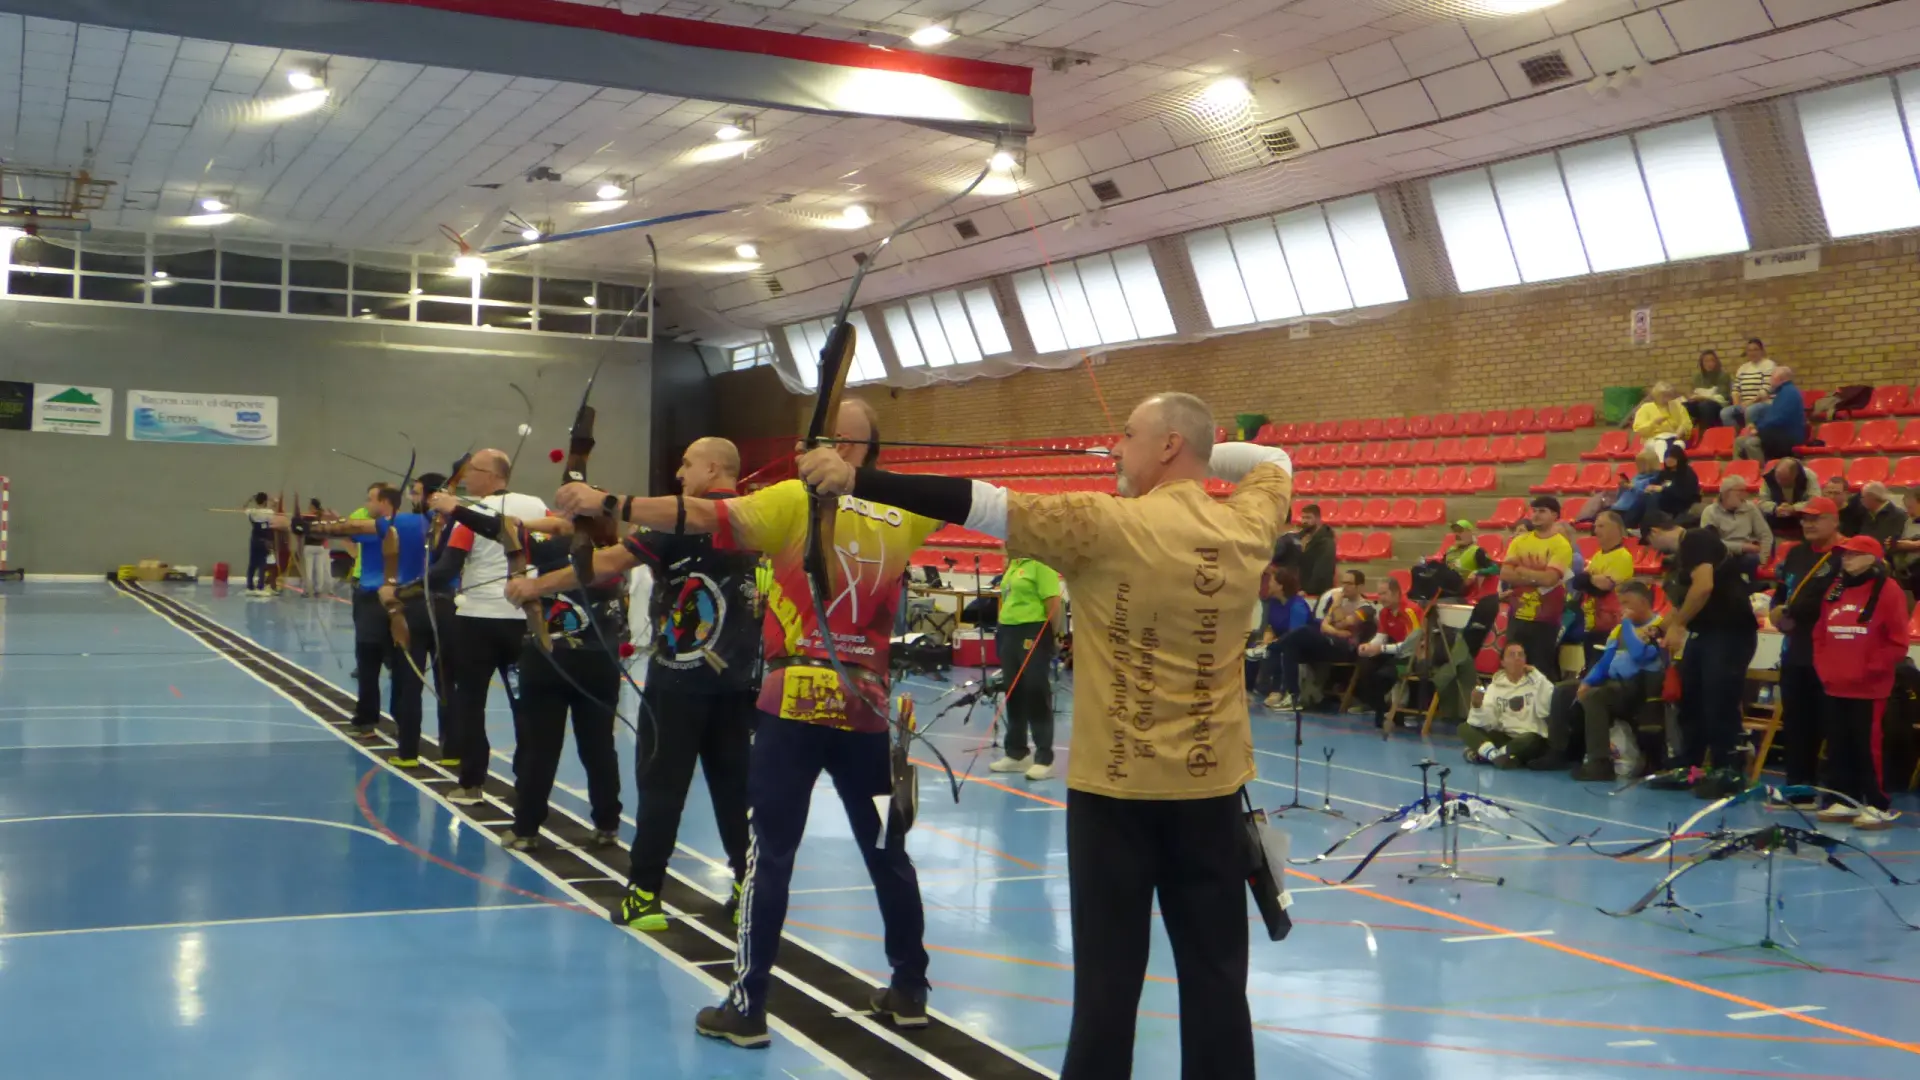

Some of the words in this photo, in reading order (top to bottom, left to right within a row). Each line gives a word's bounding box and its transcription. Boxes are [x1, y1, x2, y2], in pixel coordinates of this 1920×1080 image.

[1193, 546, 1227, 598] Cid
[1192, 607, 1218, 645] del
[1132, 700, 1154, 731] Cid
